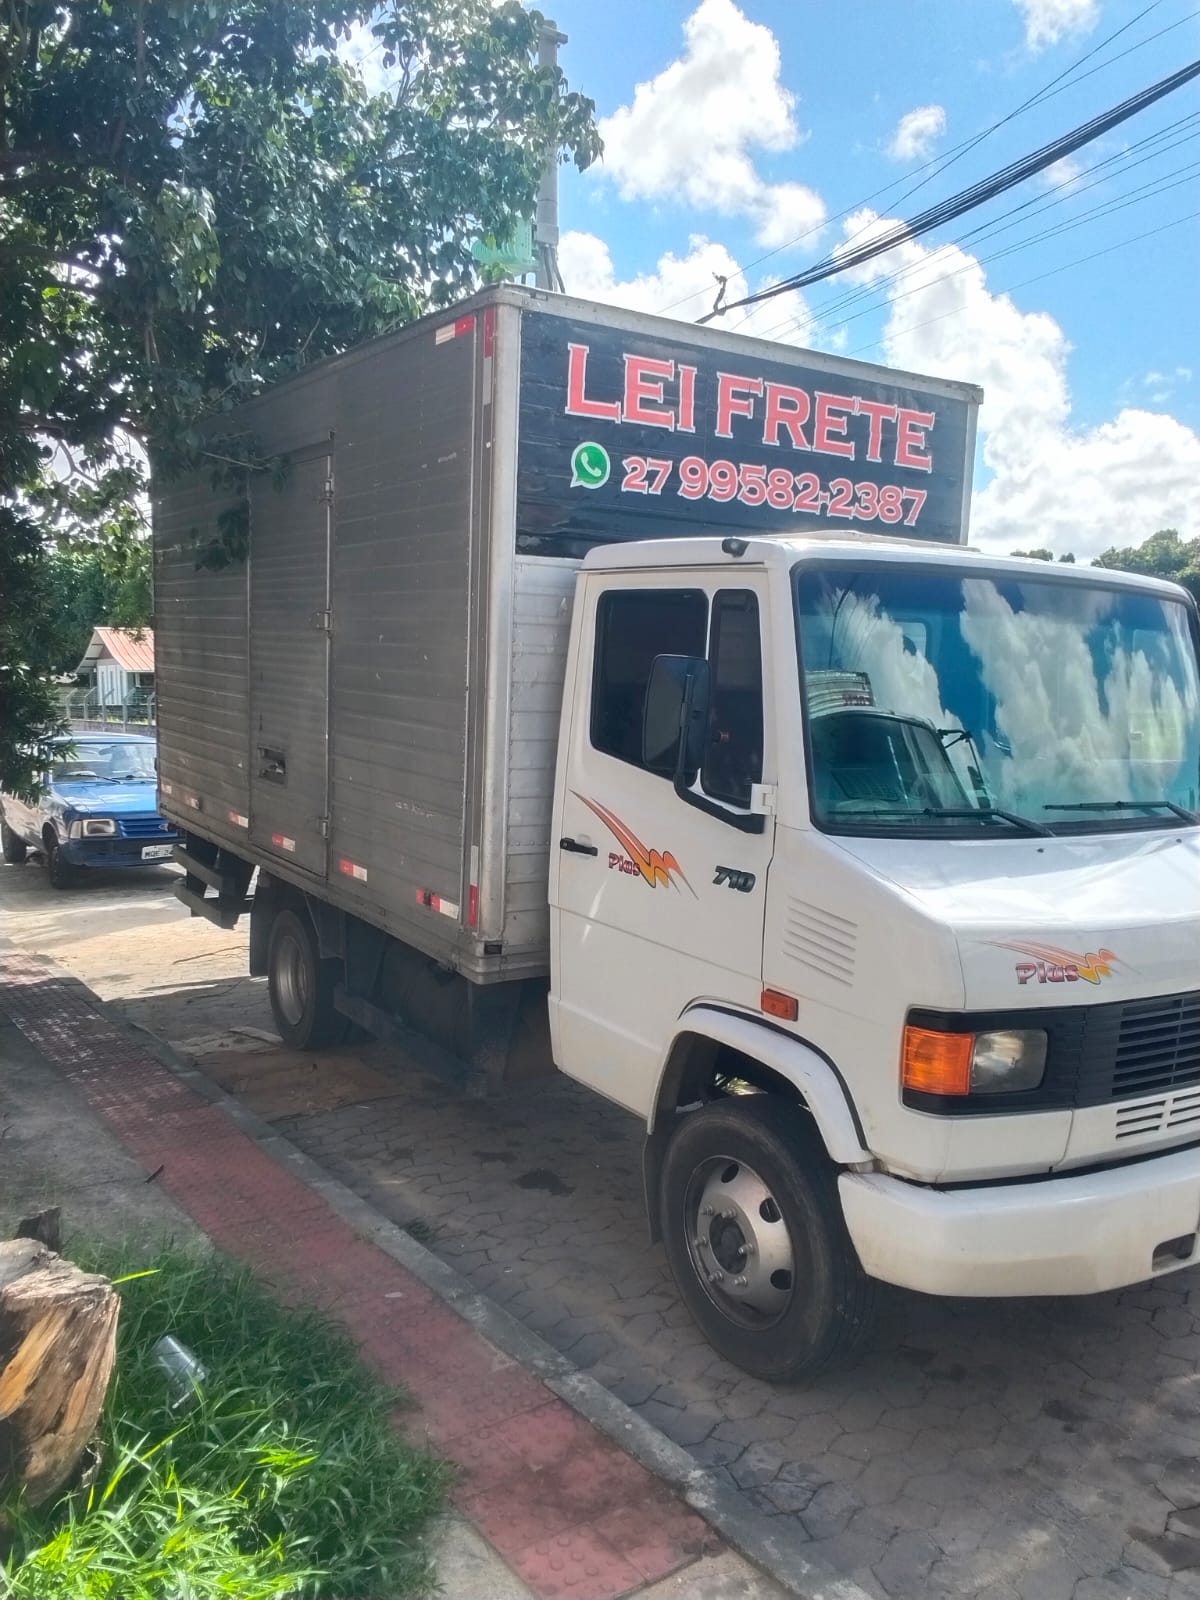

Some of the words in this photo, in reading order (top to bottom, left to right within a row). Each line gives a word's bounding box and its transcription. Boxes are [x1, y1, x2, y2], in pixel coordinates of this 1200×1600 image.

[564, 342, 697, 434] LEI
[715, 371, 936, 474] FRETE
[621, 455, 673, 496] 27
[712, 865, 757, 893] 710
[1015, 961, 1080, 985] Plus
